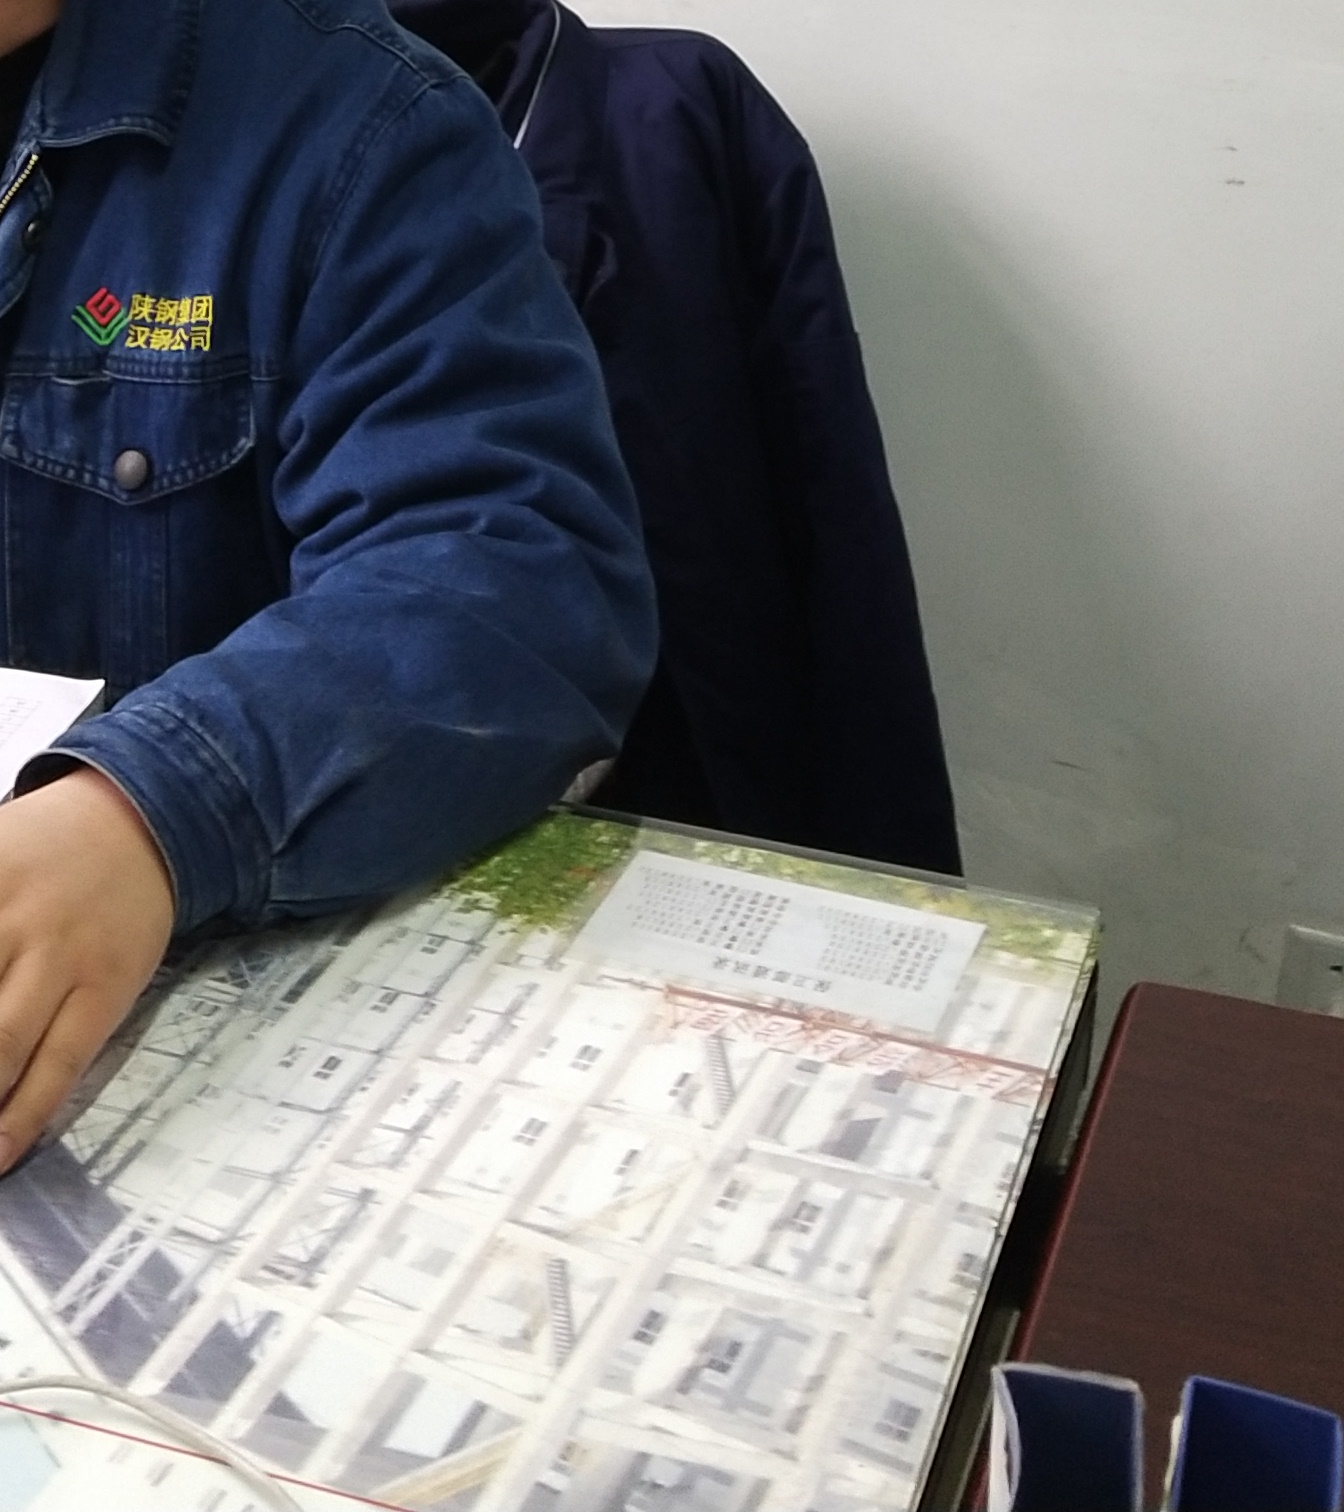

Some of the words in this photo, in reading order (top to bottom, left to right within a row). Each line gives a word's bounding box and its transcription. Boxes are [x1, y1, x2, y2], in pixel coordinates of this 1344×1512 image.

[128, 292, 214, 326] 陕钢集团
[124, 324, 212, 352] 汉钢公司
